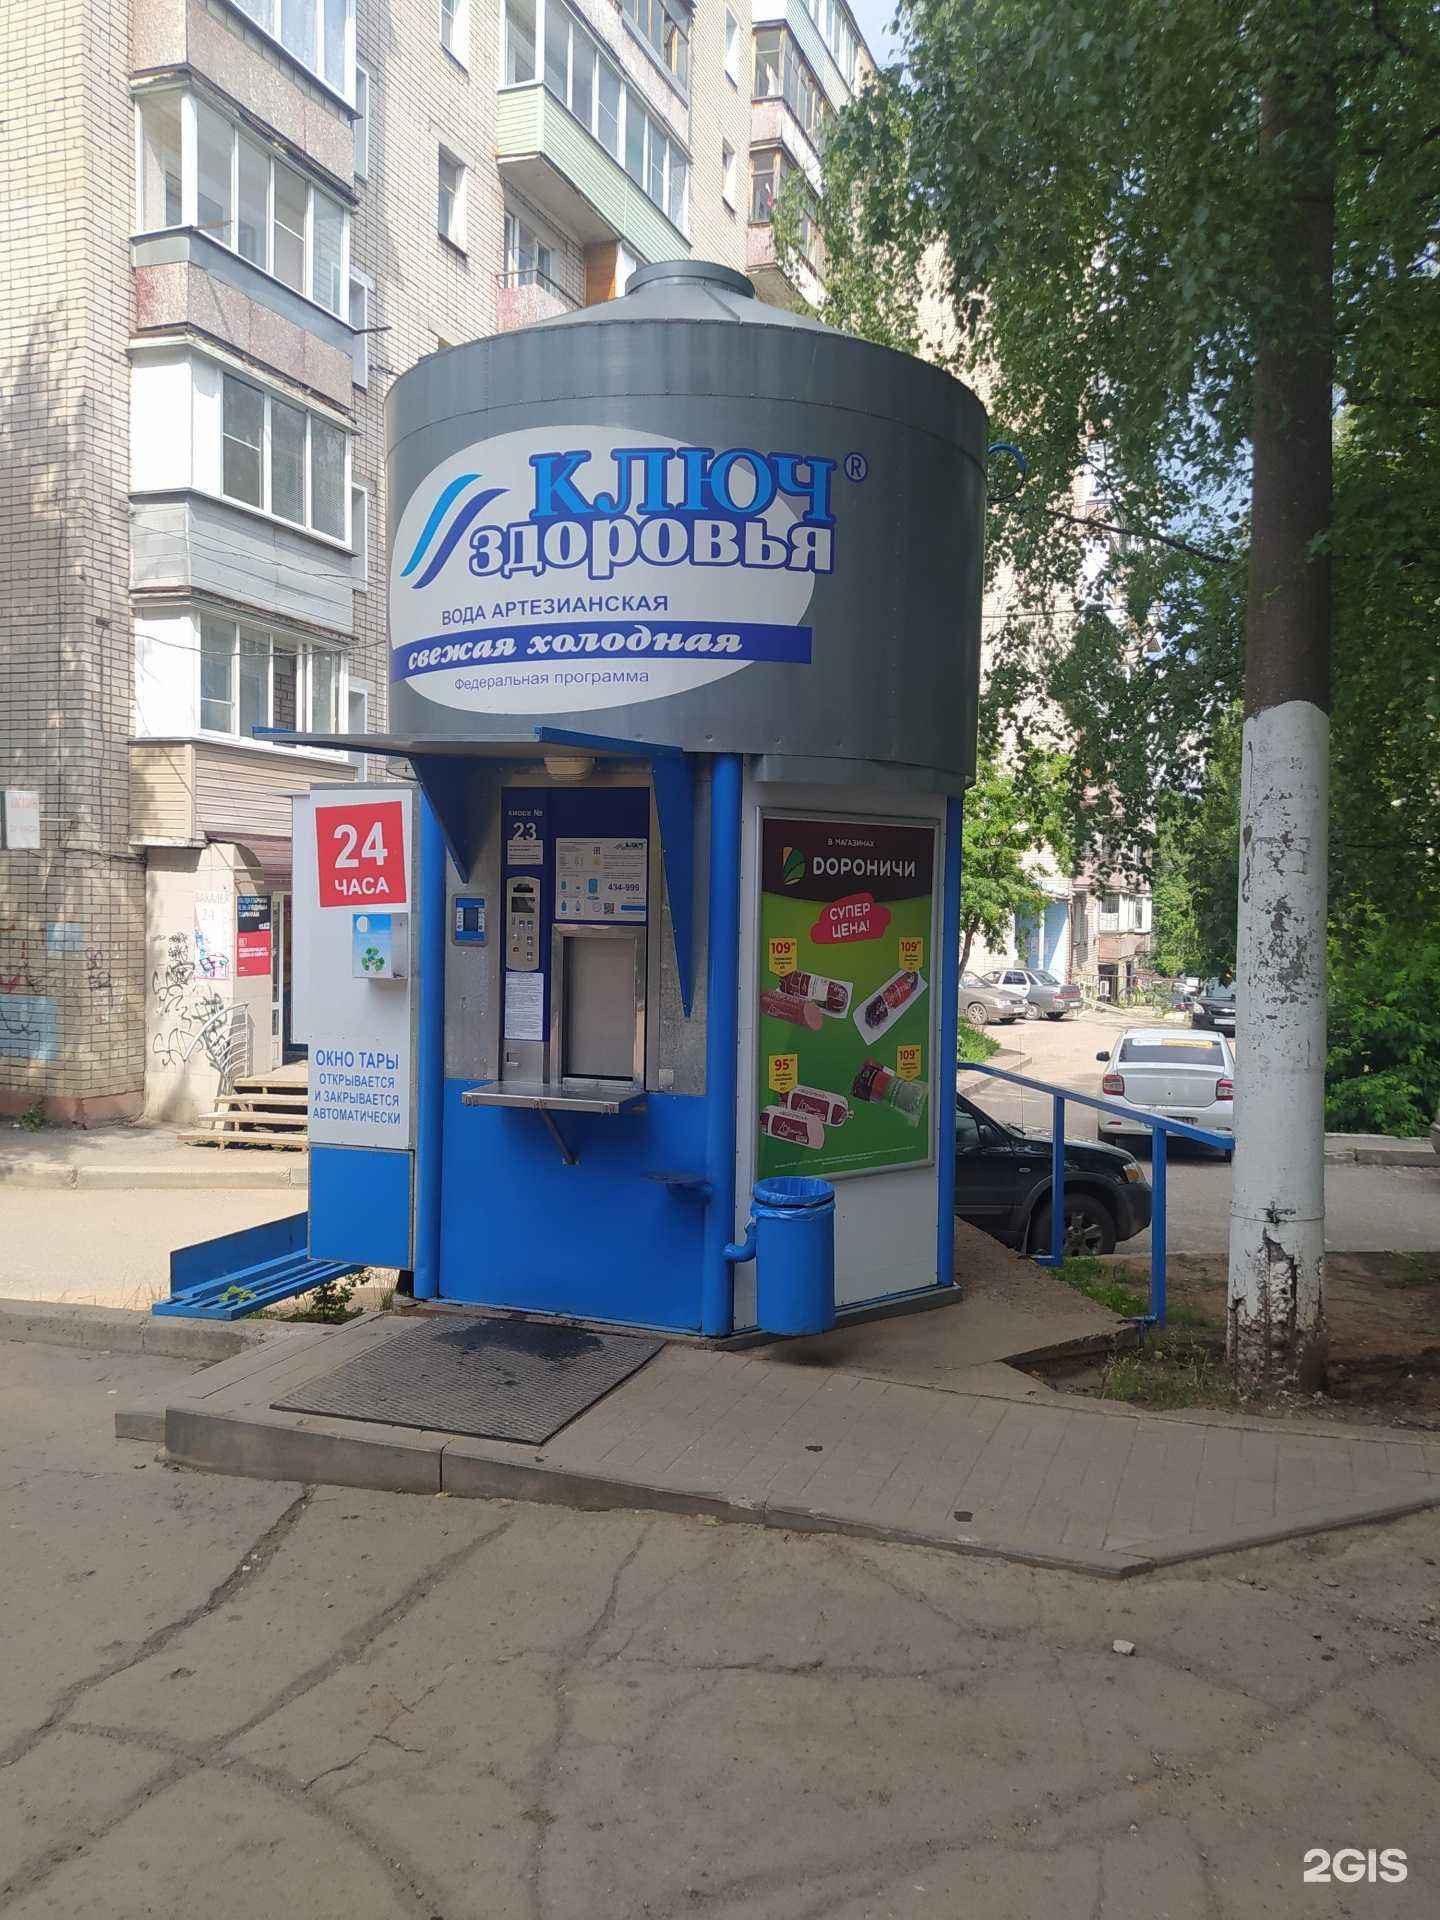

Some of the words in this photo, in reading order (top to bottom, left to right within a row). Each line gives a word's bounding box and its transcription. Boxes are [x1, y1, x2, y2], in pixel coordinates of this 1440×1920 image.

[529, 446, 838, 522] КЛЮЧ
[441, 604, 486, 625] ВОДА
[491, 595, 669, 619] АРТЕЗИАНСКАЯ
[408, 637, 517, 670] свежая
[526, 624, 742, 655] холодная
[454, 672, 549, 691] Федеральная
[554, 670, 650, 686] программа
[512, 822, 537, 840] 23
[333, 821, 388, 869] 24
[835, 838, 874, 847] МАГАЗИНАХ
[334, 876, 390, 897] ЧАСА
[829, 902, 871, 921] СУПЕР
[832, 919, 870, 938] ЦЕНА!
[315, 1049, 355, 1068] ОКНО
[358, 1051, 399, 1069] ТАРЫ
[319, 1073, 395, 1089] ОТКРЫВАЕТСЯ
[314, 1090, 321, 1101] И
[324, 1090, 400, 1107] ЗАКРЫВАЕТСЯ
[312, 1107, 401, 1125] АВТОМАТИЧЕСКИ
